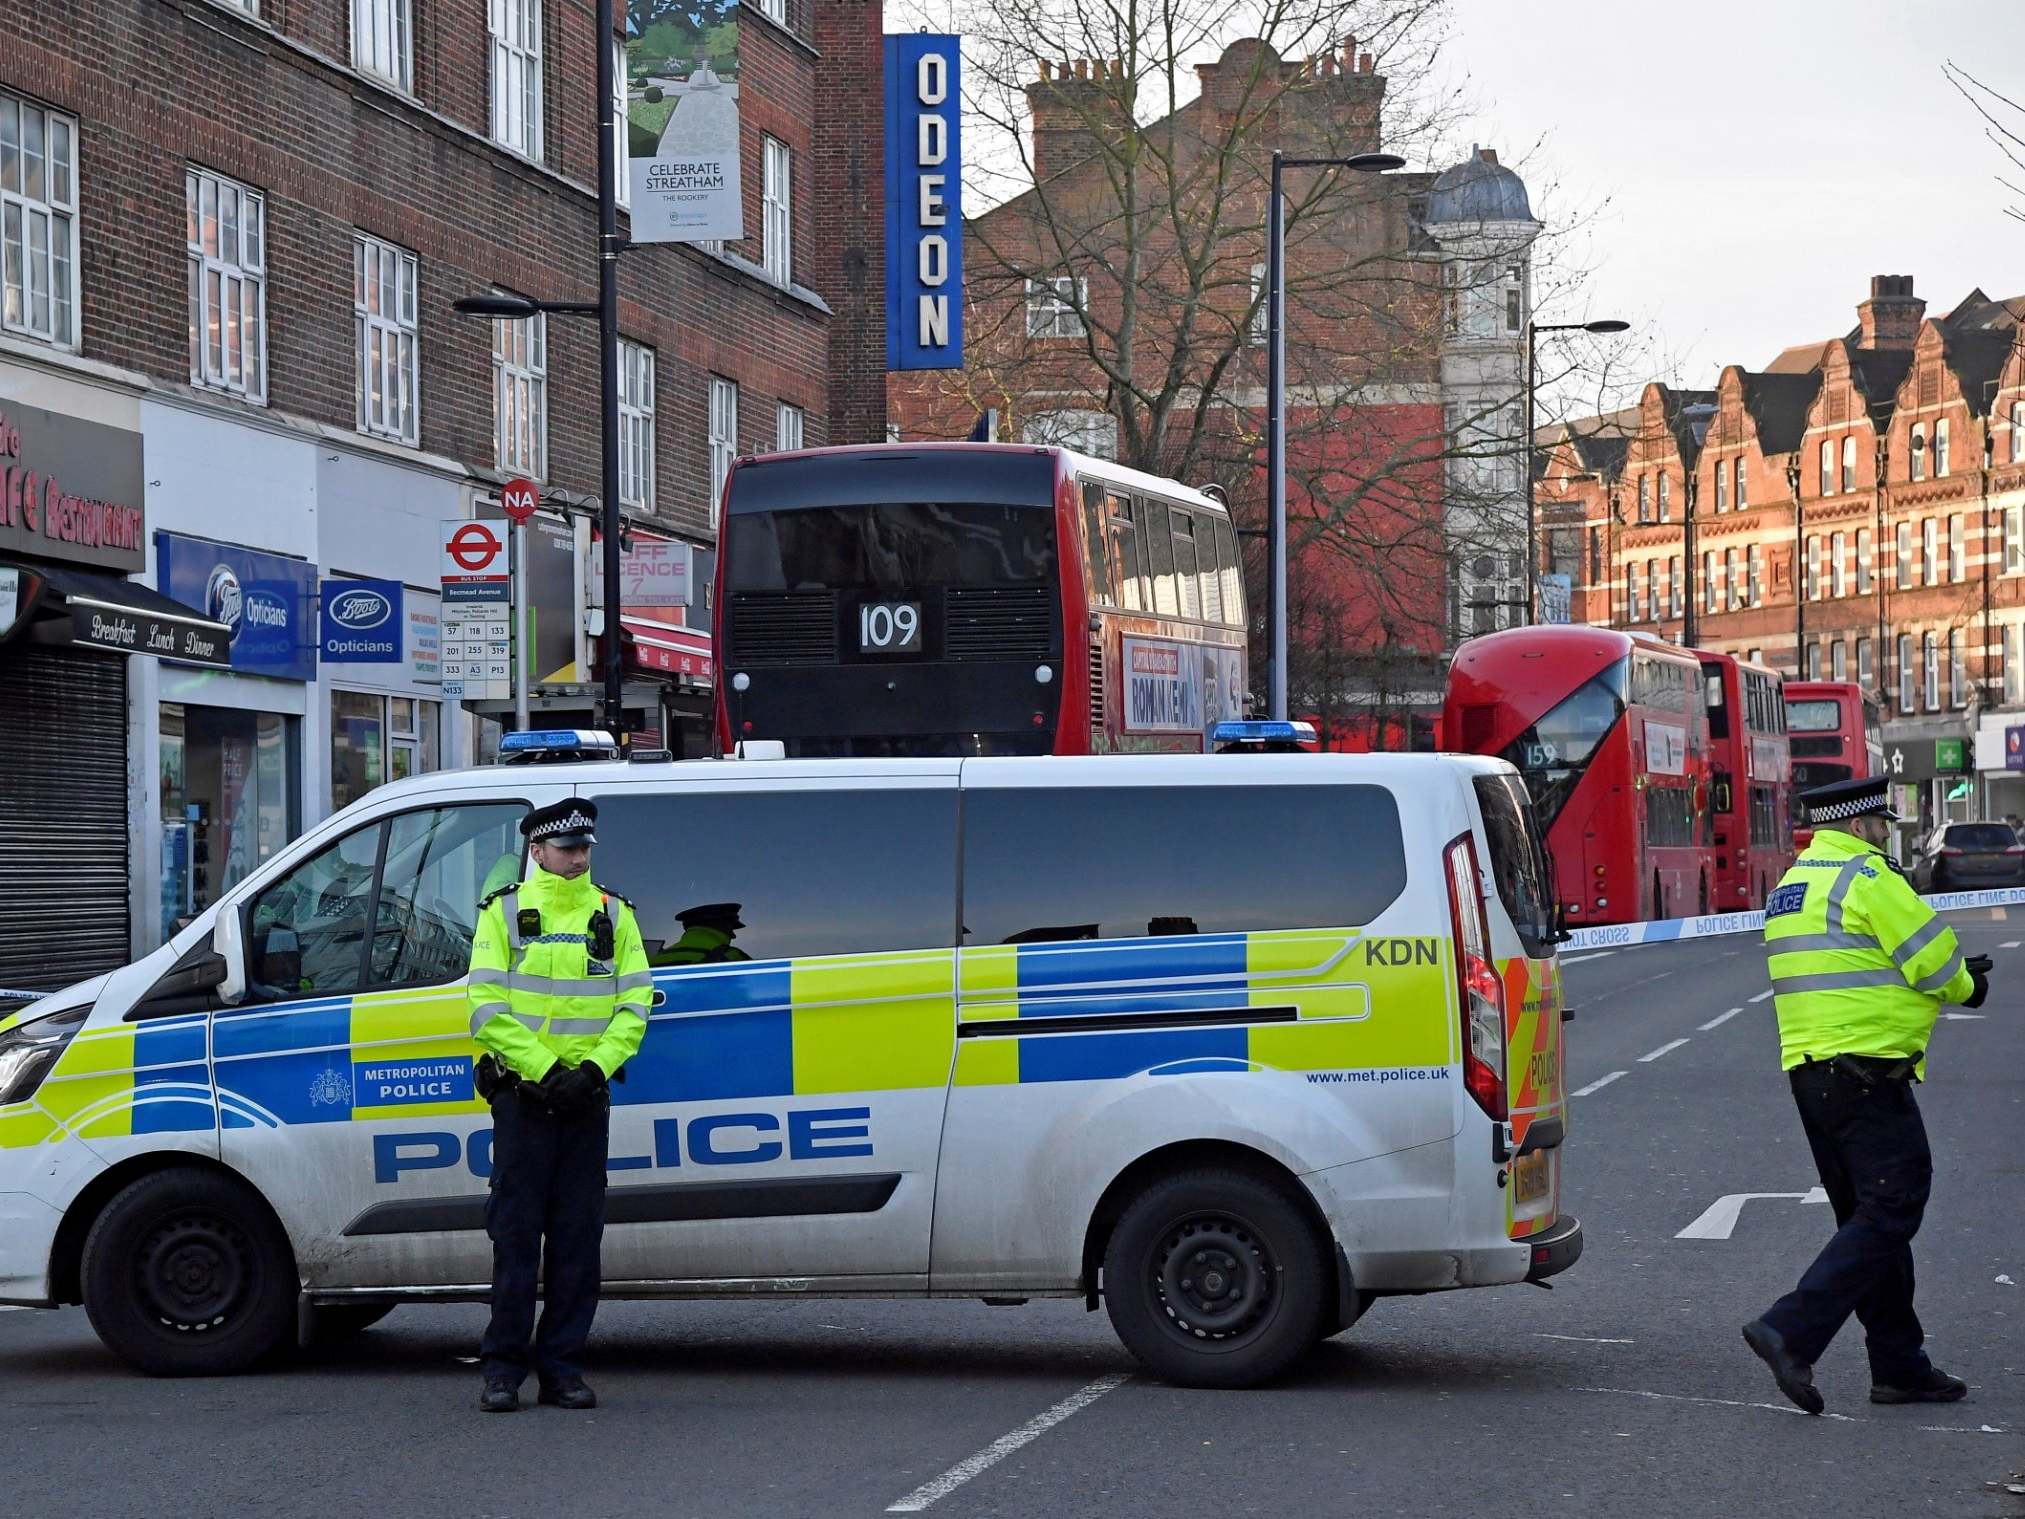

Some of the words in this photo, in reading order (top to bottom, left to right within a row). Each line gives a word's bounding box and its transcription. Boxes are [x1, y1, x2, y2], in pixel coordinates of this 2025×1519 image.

[650, 162, 720, 176] CELEBRATE
[646, 176, 724, 189] STREATHAM
[677, 193, 709, 202] ROOKERY
[918, 53, 948, 346] ODEON
[505, 491, 535, 507] NA
[595, 562, 685, 576] LCENCE
[218, 583, 242, 625] Boots
[338, 598, 381, 621] Boots
[246, 596, 287, 628] Opticians
[447, 627, 457, 635] 57
[469, 627, 481, 635] 118
[491, 627, 505, 635] 133
[860, 604, 918, 647] 109
[91, 614, 137, 645] Breakfast
[146, 624, 175, 651] Lunch
[184, 631, 215, 657] Dinner
[327, 638, 393, 655] Opticians
[446, 647, 459, 655] 201
[468, 646, 482, 654] 255
[492, 647, 505, 655] 319
[445, 666, 460, 674] 333
[470, 666, 481, 674] A3
[491, 666, 505, 674] P13
[443, 687, 462, 695] N133
[1132, 677, 1166, 724] ROMAN
[1526, 744, 1557, 766] 159
[1366, 939, 1438, 967] KDN
[365, 1064, 465, 1081] METROPOLITAN
[1306, 1066, 1450, 1085] www.met.police.uk
[380, 1082, 452, 1098] POLICE
